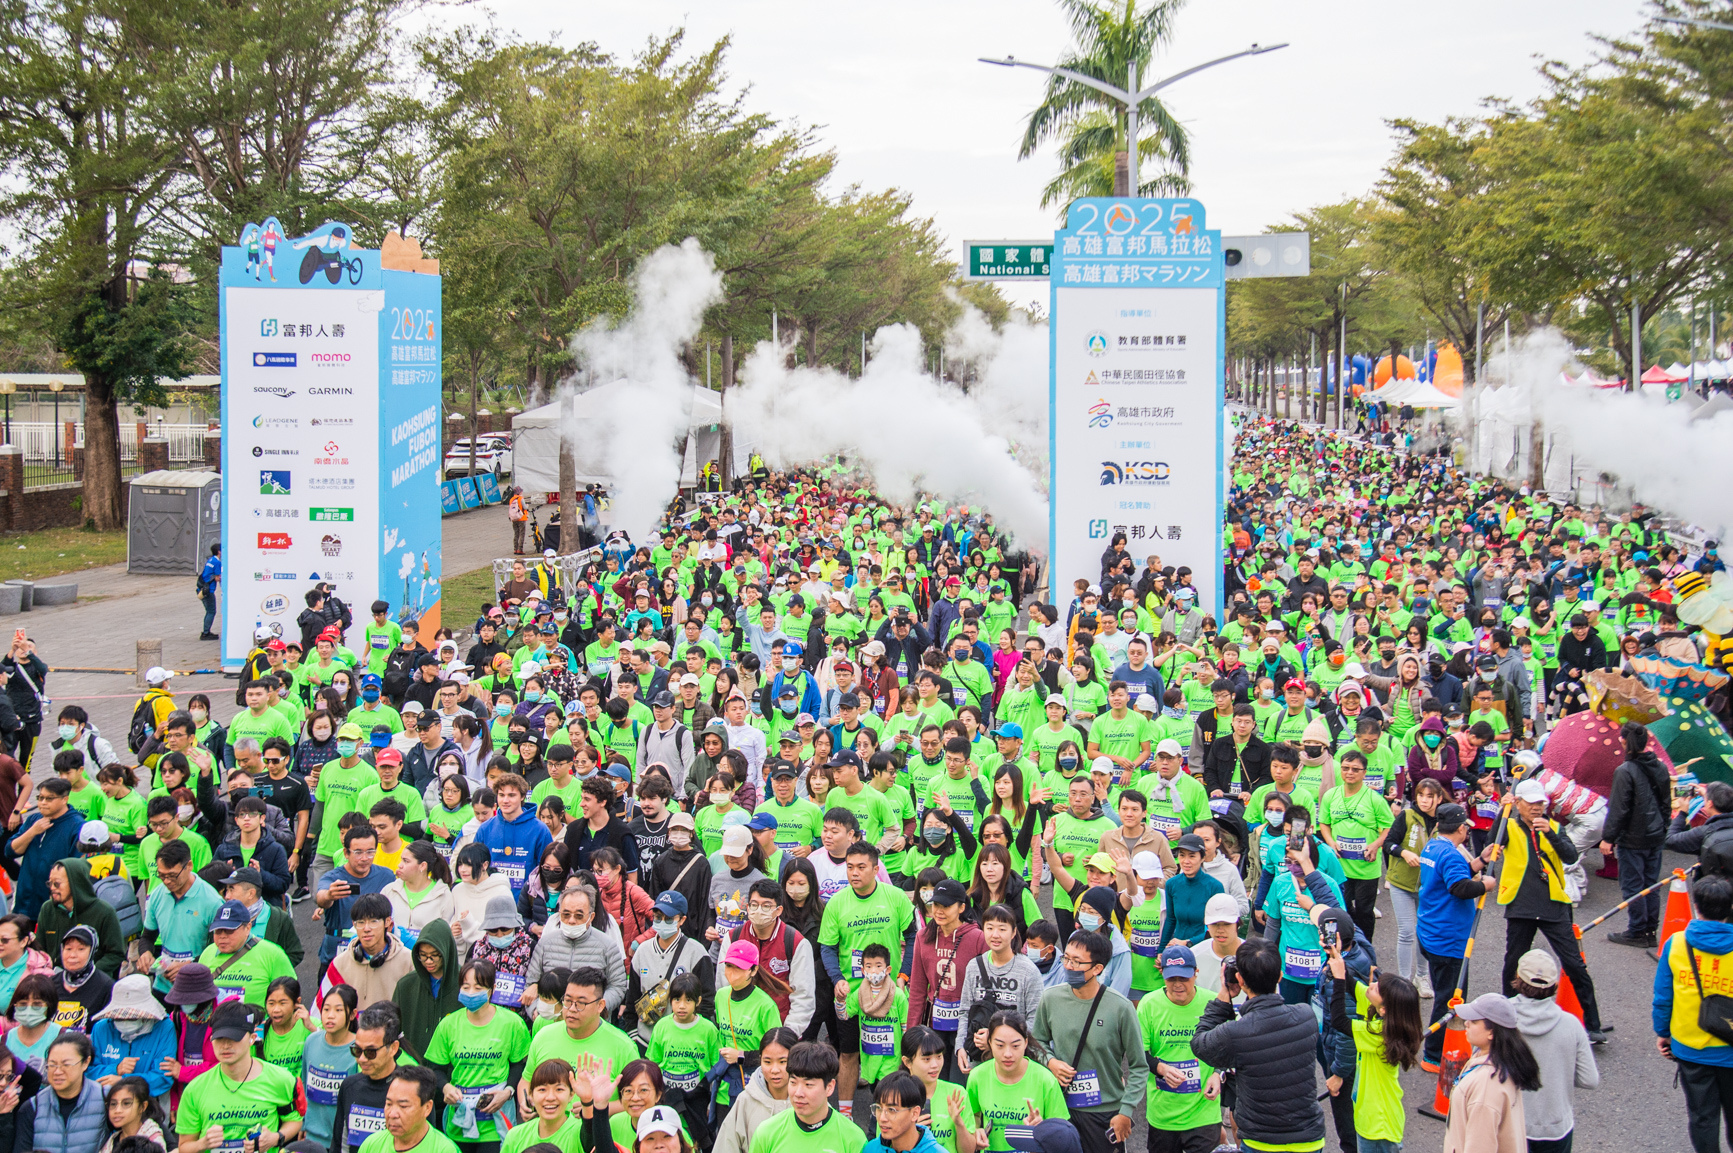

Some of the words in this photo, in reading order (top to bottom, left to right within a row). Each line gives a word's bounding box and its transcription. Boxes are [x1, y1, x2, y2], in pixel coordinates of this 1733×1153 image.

[1076, 202, 1192, 236] 2025
[1062, 235, 1212, 256] 高雄富邦馬拉松
[980, 248, 1045, 263] 國家體
[980, 264, 1038, 275] National
[1063, 264, 1210, 284] 高雄富邦マラソン
[391, 307, 433, 340] 2025
[283, 324, 345, 338] 富邦人壽
[1118, 335, 1186, 345] 教育部體育署
[312, 354, 351, 362] momo
[391, 345, 436, 361] 高雄富邦馬拉松
[392, 370, 436, 385] 高雄富邦マラソン
[1102, 369, 1186, 380] 中華民國田徑協會
[254, 386, 288, 394] saucony
[1117, 407, 1174, 418] 高雄市政府
[392, 405, 436, 446] KAOHSIUNG
[409, 424, 436, 456] FUBON
[392, 444, 436, 488] MARATHON
[1125, 462, 1170, 480] KSD
[1113, 525, 1182, 540] 富邦人壽
[327, 784, 357, 792] KAOHSIUNG
[1062, 834, 1099, 844] KAOHSIUNG
[847, 916, 890, 928] KAOHSIUNG
[1289, 956, 1315, 965] 51081
[937, 958, 957, 991] 9
[936, 1008, 959, 1017] 5070
[863, 1032, 888, 1042] 51654
[311, 1077, 340, 1090] 50840
[209, 1110, 268, 1120] KAOHSIUNG
[652, 1109, 663, 1122] A
[355, 1118, 387, 1131] 51753
